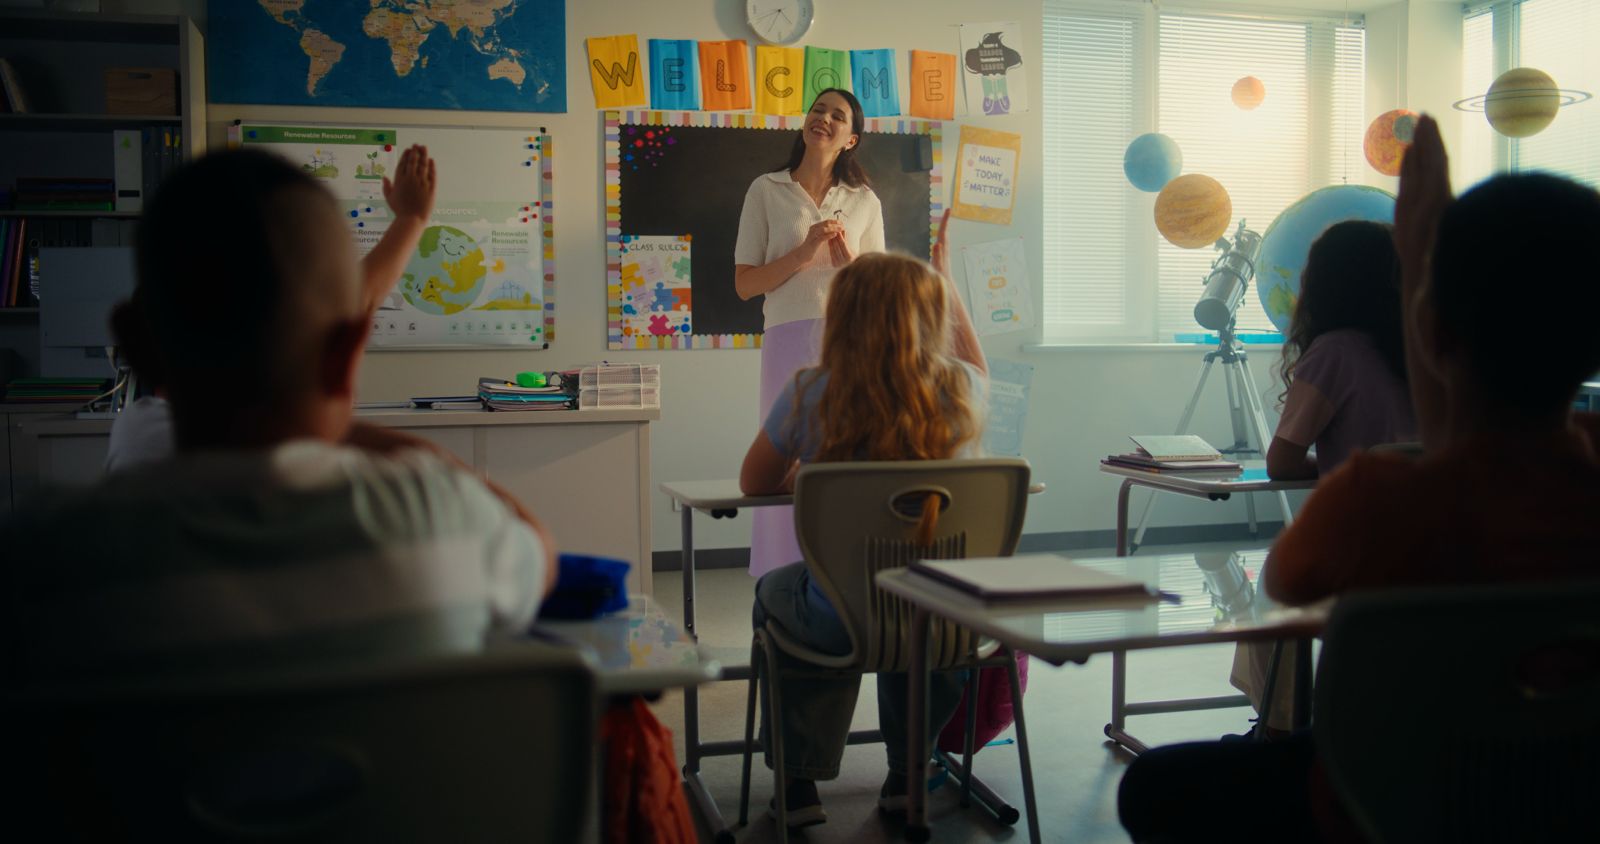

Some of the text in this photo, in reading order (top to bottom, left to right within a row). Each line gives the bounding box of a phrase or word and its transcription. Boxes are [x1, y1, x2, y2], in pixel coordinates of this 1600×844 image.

[979, 155, 1001, 167] MAKE
[976, 169, 1002, 180] TODAY
[969, 184, 1005, 196] MATTER
[491, 230, 528, 238] Renewable
[629, 243, 654, 251] CLASS
